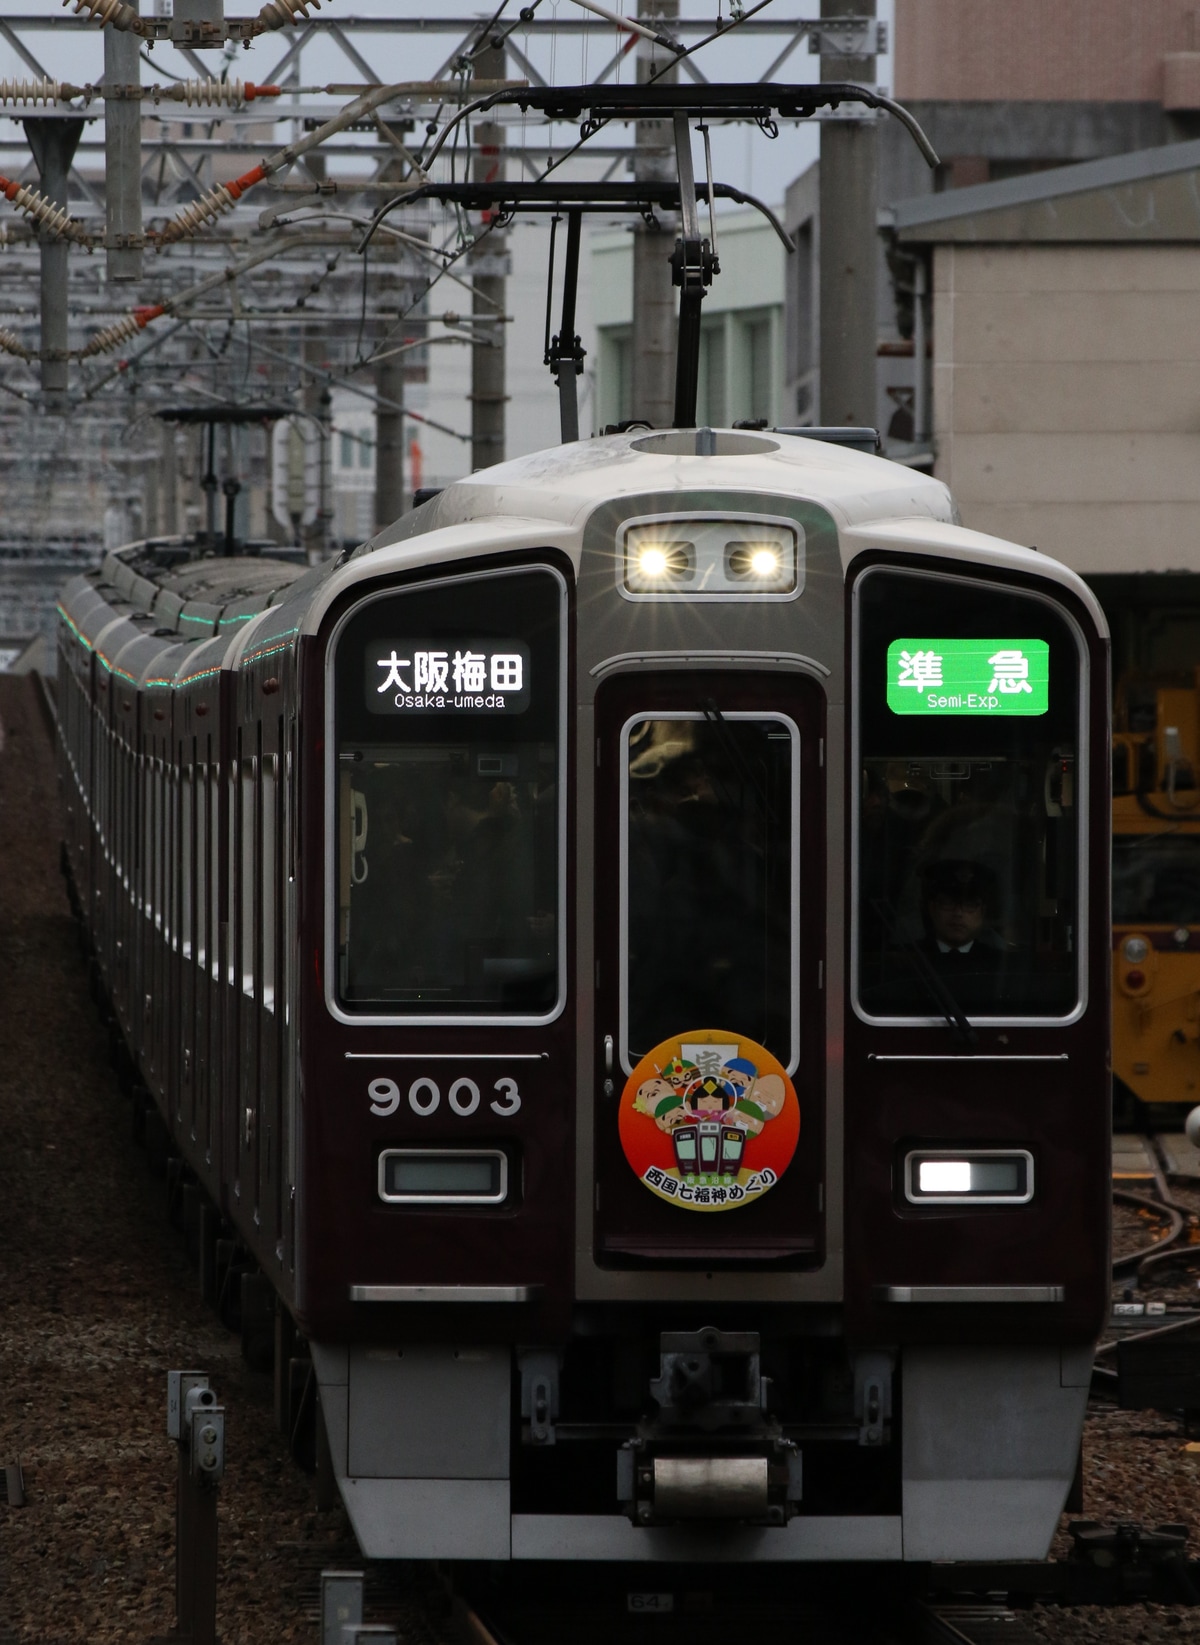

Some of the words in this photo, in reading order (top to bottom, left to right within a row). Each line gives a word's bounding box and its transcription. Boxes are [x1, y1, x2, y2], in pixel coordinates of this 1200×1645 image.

[377, 650, 523, 693] 大阪梅田
[394, 694, 506, 708] Osaka-umeda
[927, 693, 1002, 710] Semi-Exp.
[367, 1077, 522, 1117] 9003
[646, 1168, 776, 1203] 西国七福神めぐり
